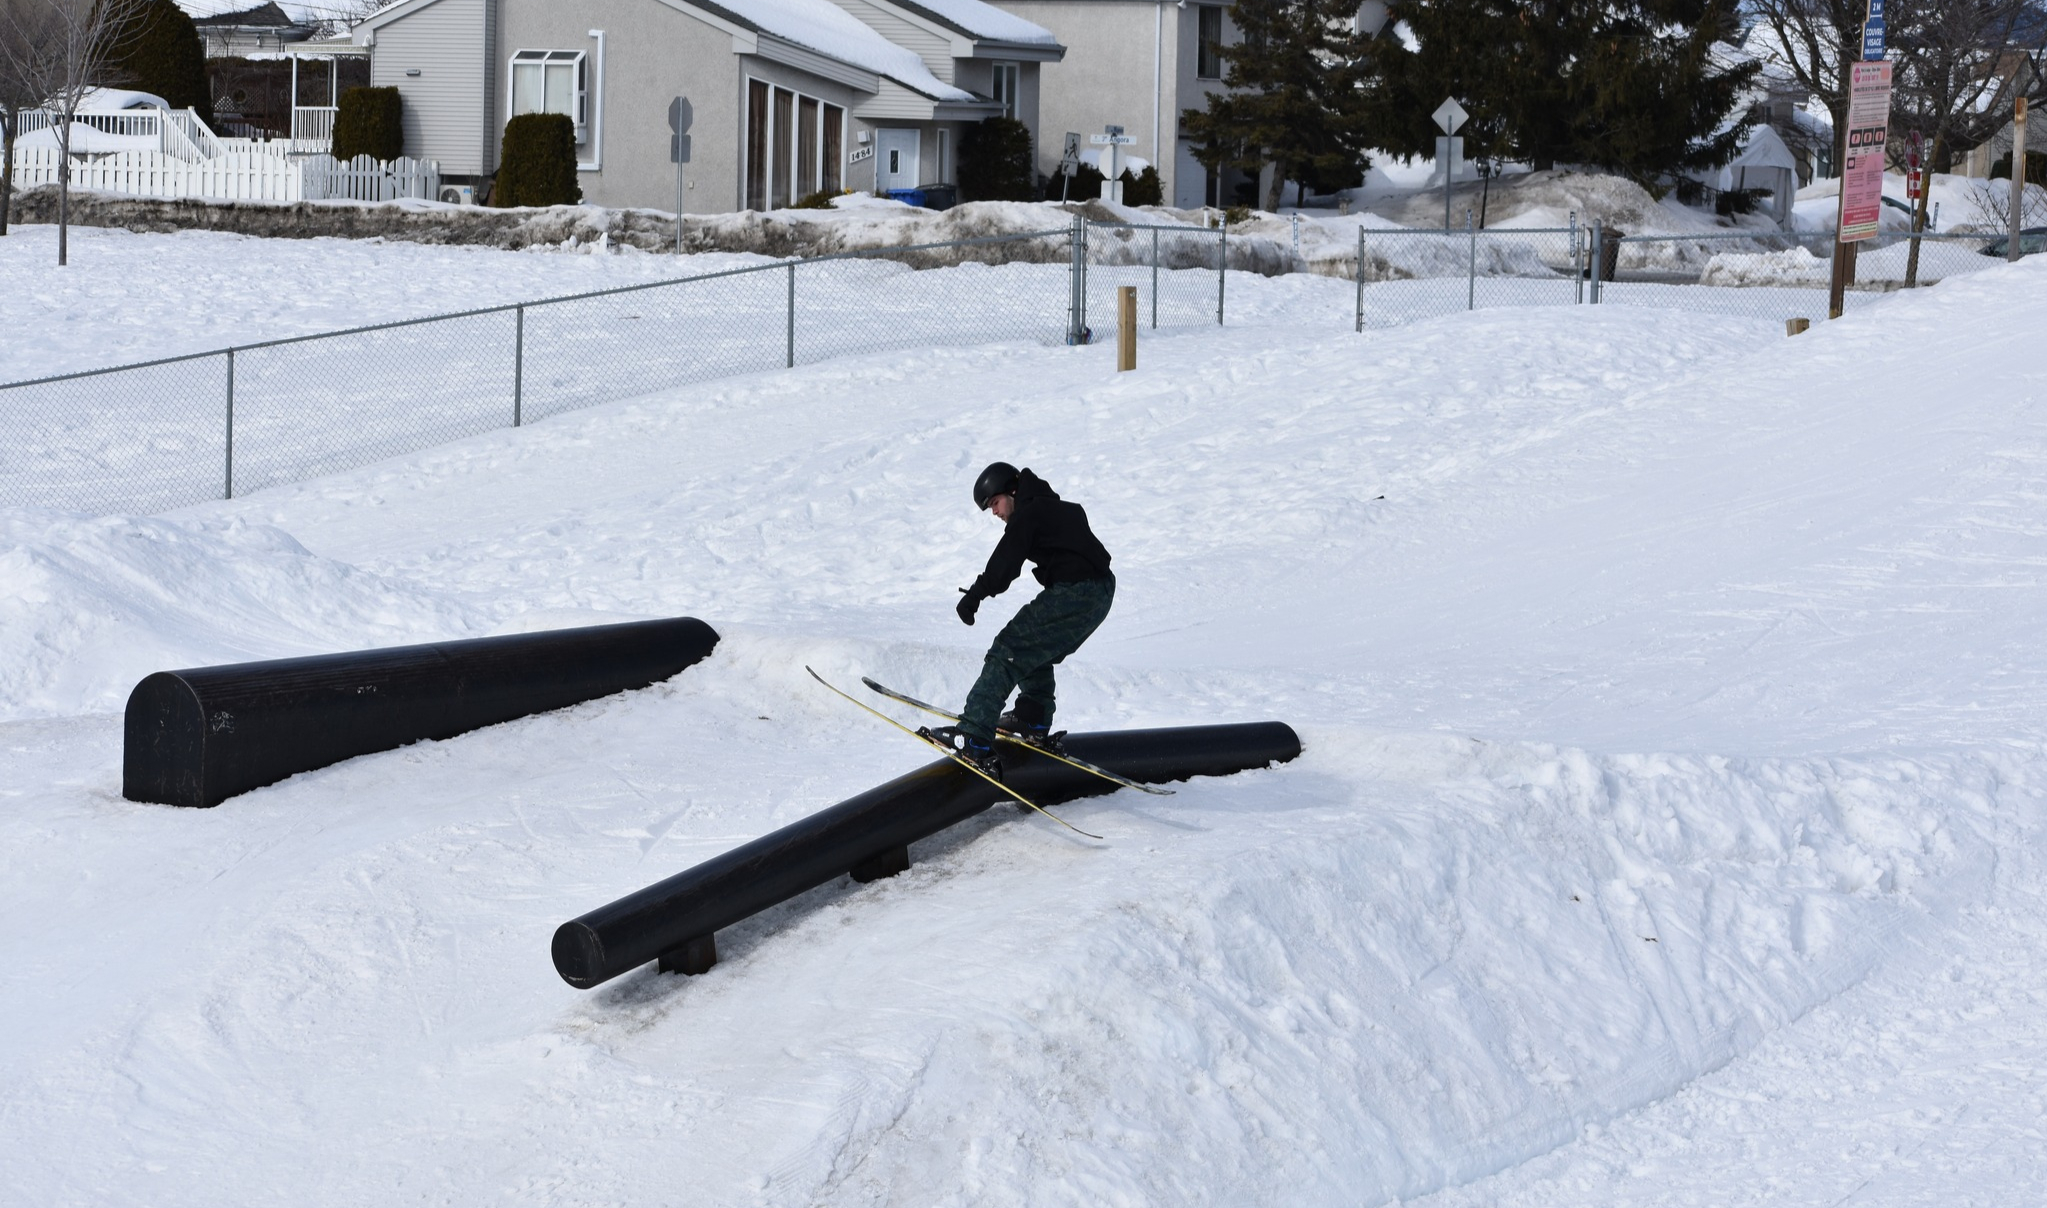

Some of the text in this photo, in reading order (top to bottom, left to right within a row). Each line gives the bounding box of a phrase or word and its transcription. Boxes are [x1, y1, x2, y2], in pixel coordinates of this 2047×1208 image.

[1866, 28, 1884, 36] COUVRE-
[1866, 38, 1882, 46] VISAGE
[852, 147, 870, 161] 1484
